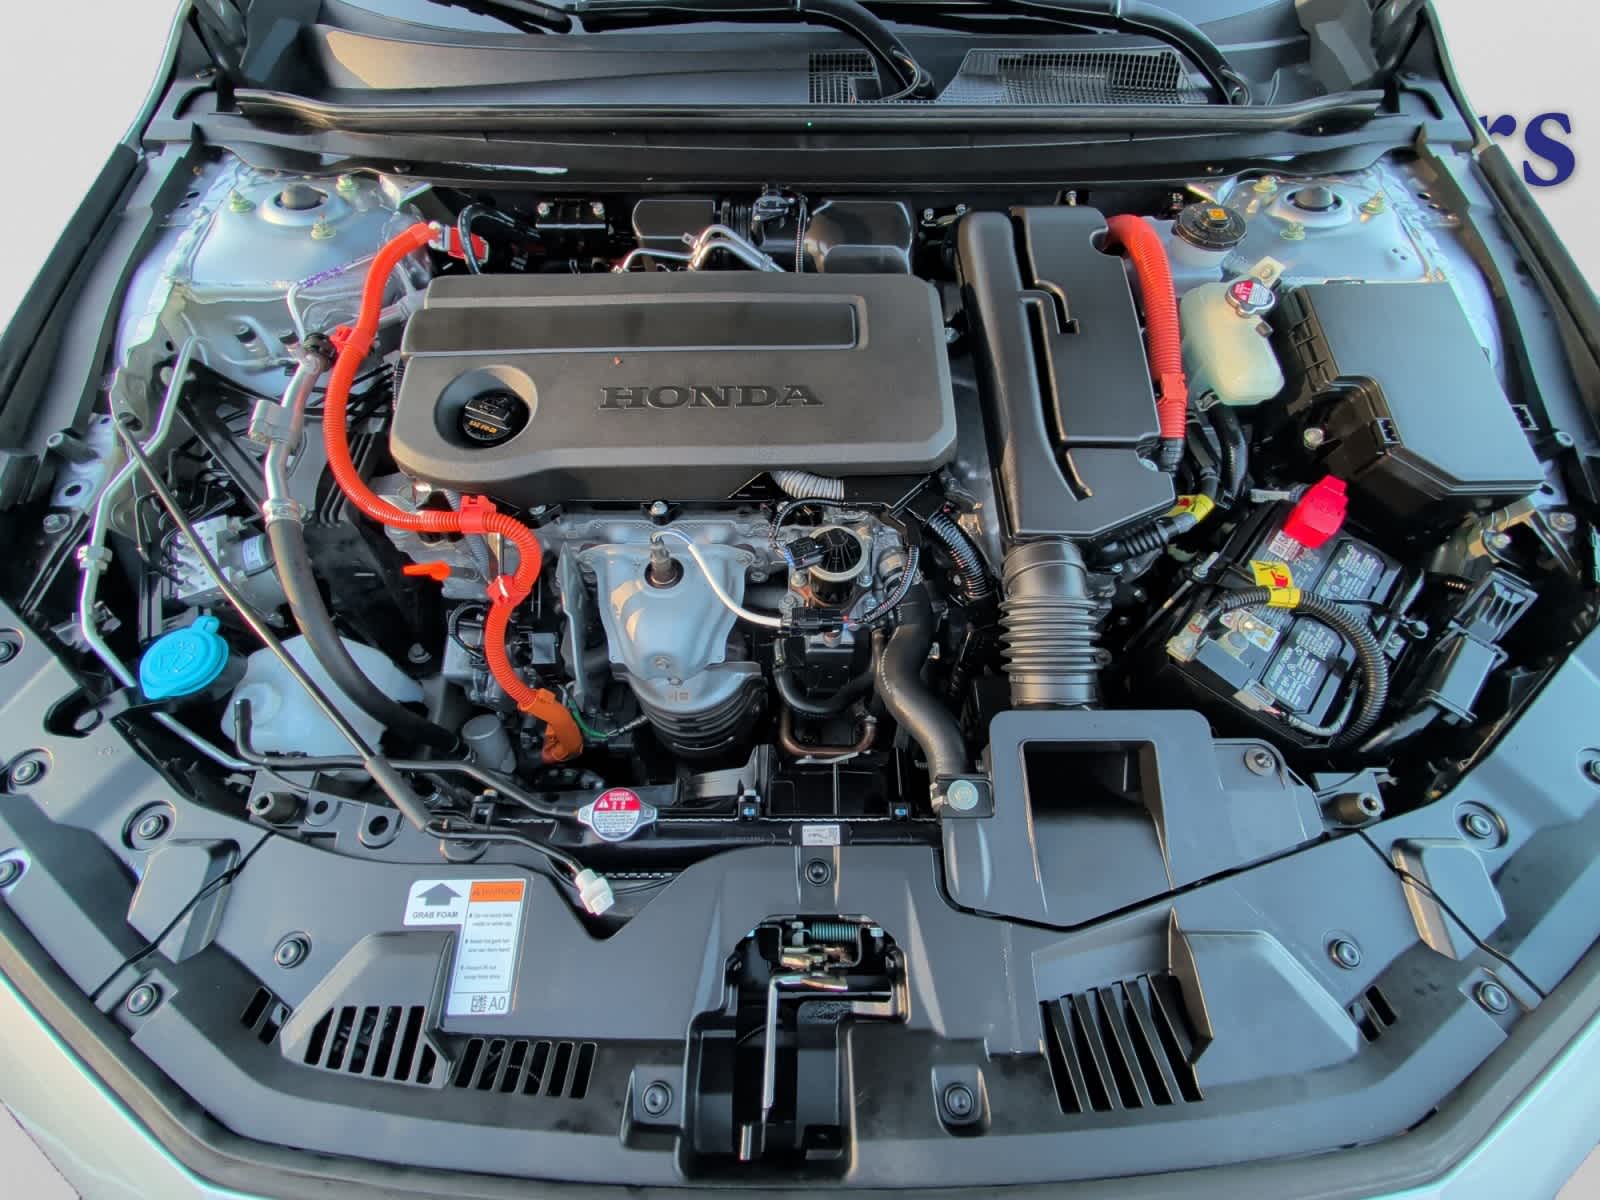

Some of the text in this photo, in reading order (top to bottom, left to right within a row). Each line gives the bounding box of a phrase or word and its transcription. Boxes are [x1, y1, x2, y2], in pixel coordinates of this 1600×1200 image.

[598, 385, 824, 409] HONDA
[412, 911, 459, 919] GRAB FOAM
